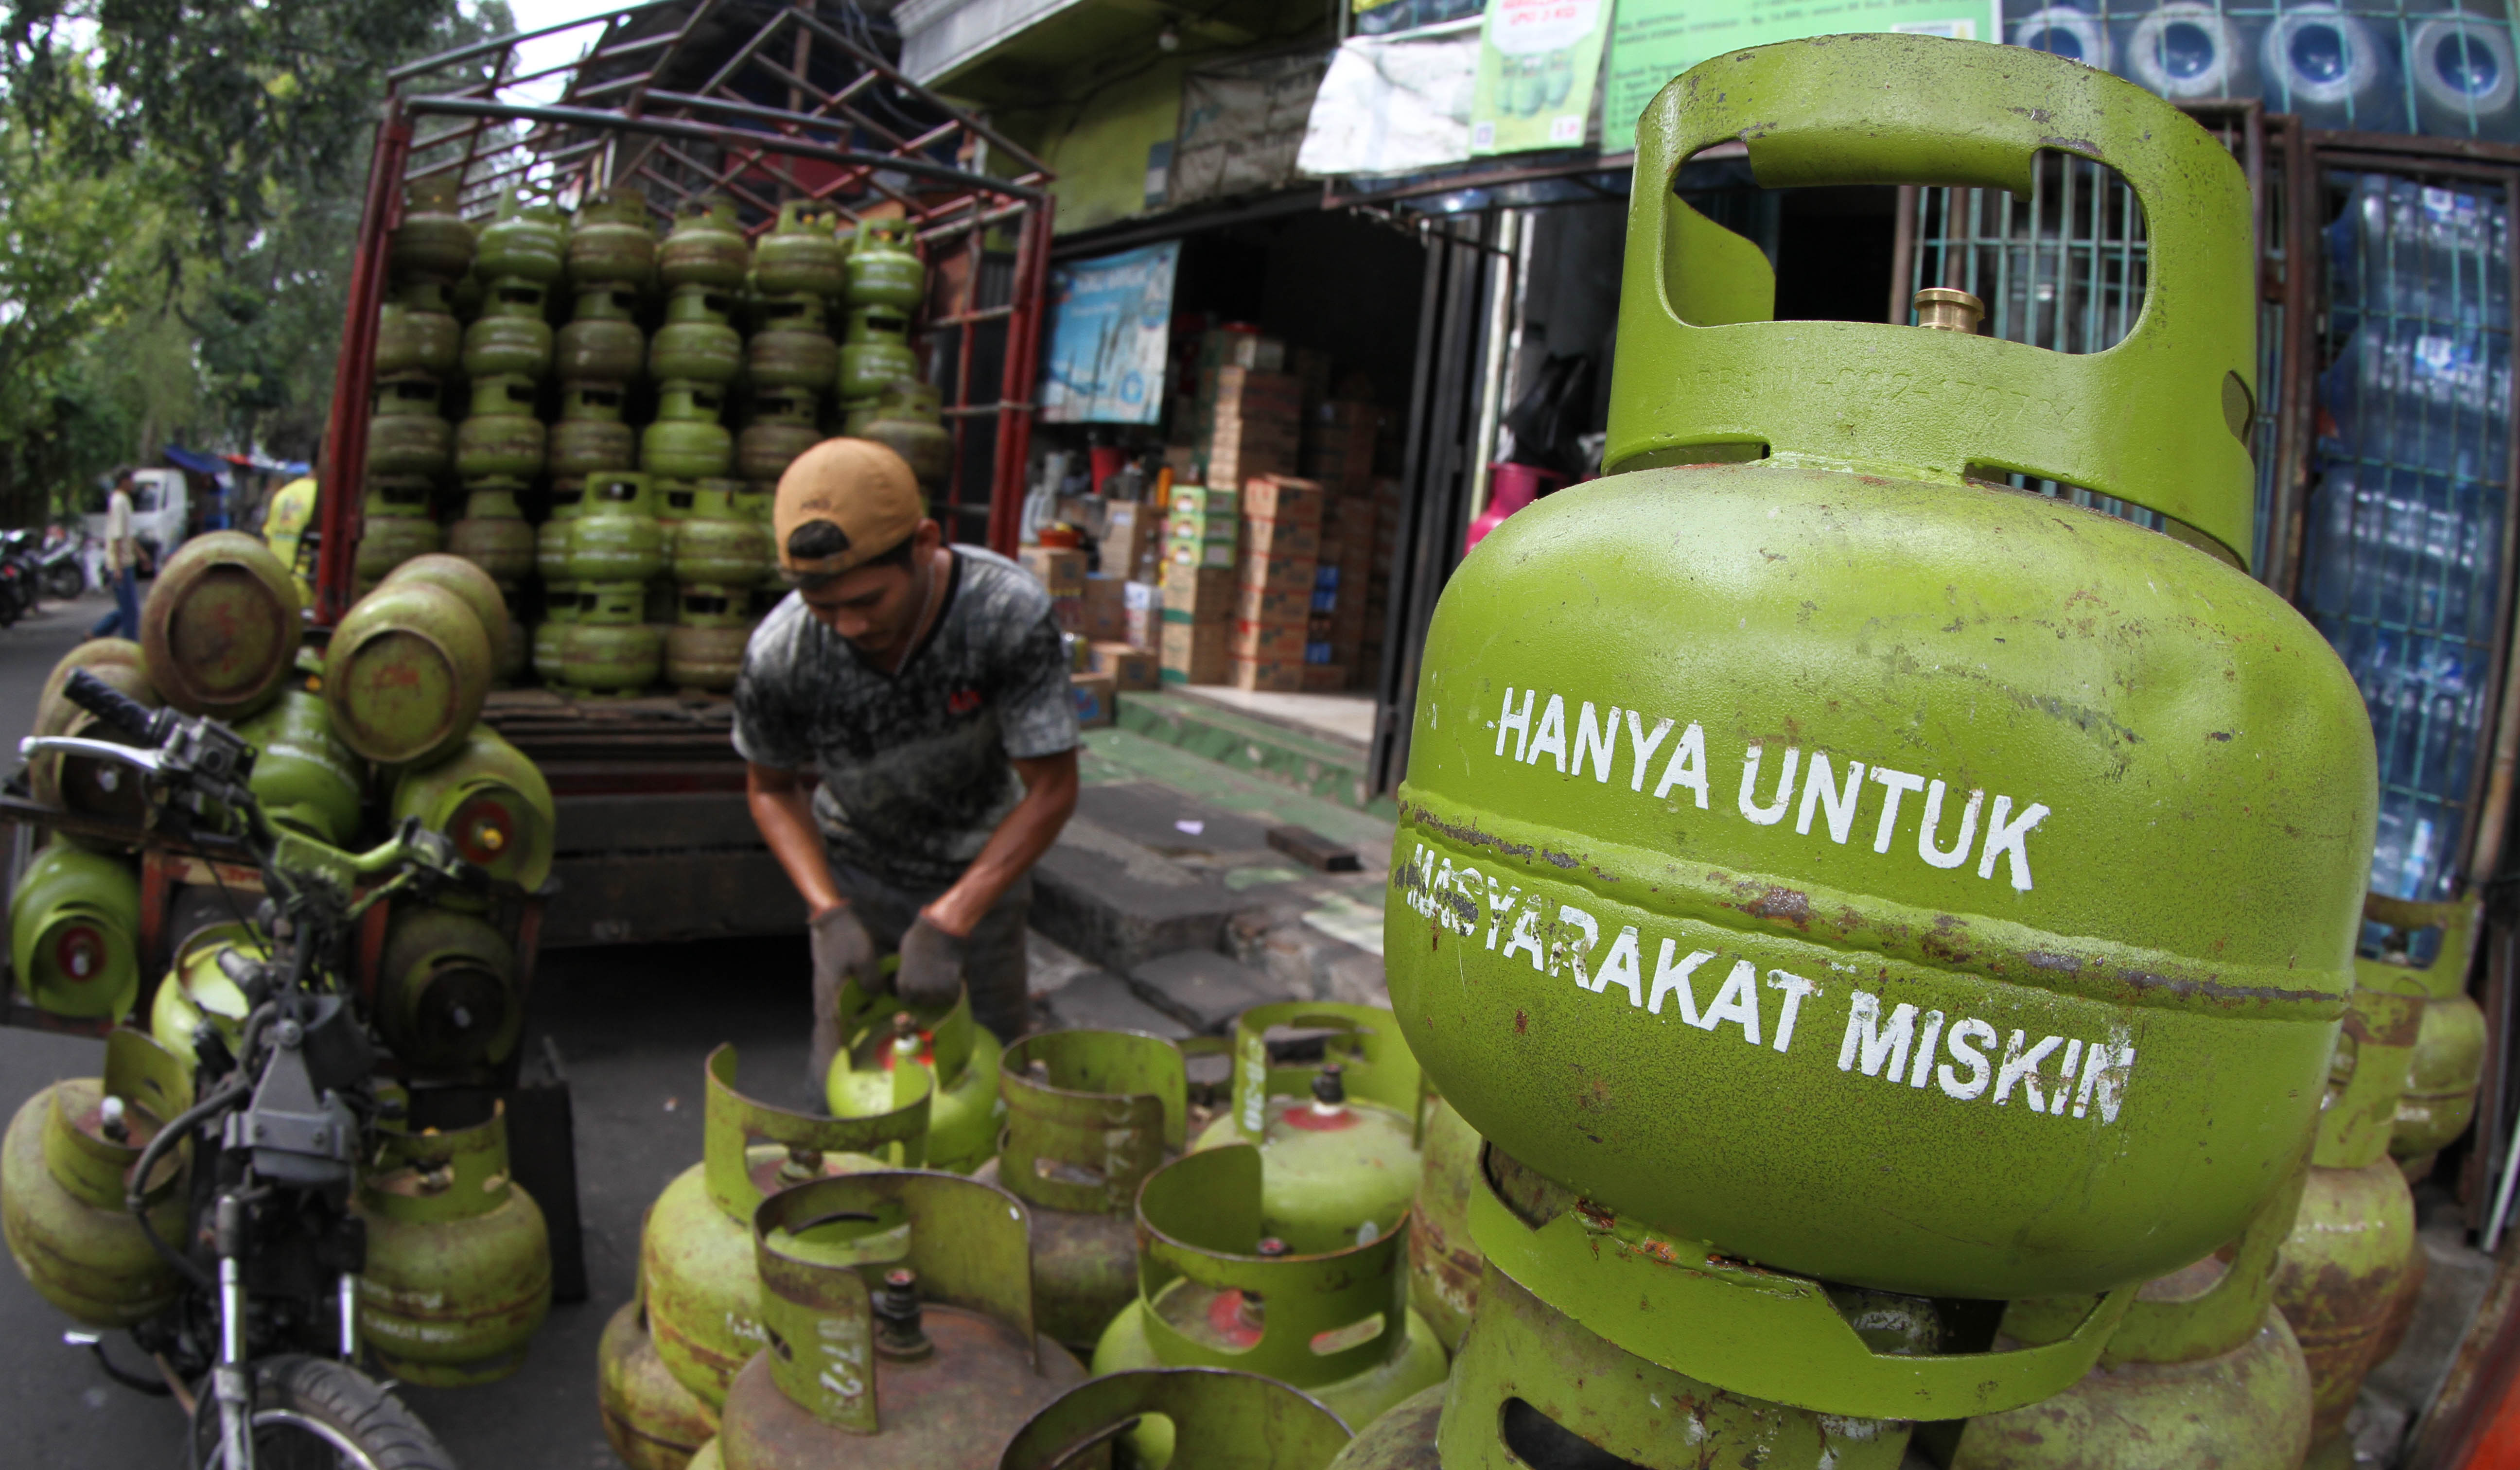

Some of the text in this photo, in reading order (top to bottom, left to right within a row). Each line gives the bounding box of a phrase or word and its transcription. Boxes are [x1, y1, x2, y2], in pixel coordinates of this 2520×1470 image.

[1495, 686, 2051, 892] HANYA UNTUK
[1406, 843, 2135, 1124] MASYARAKAT MISKIN
